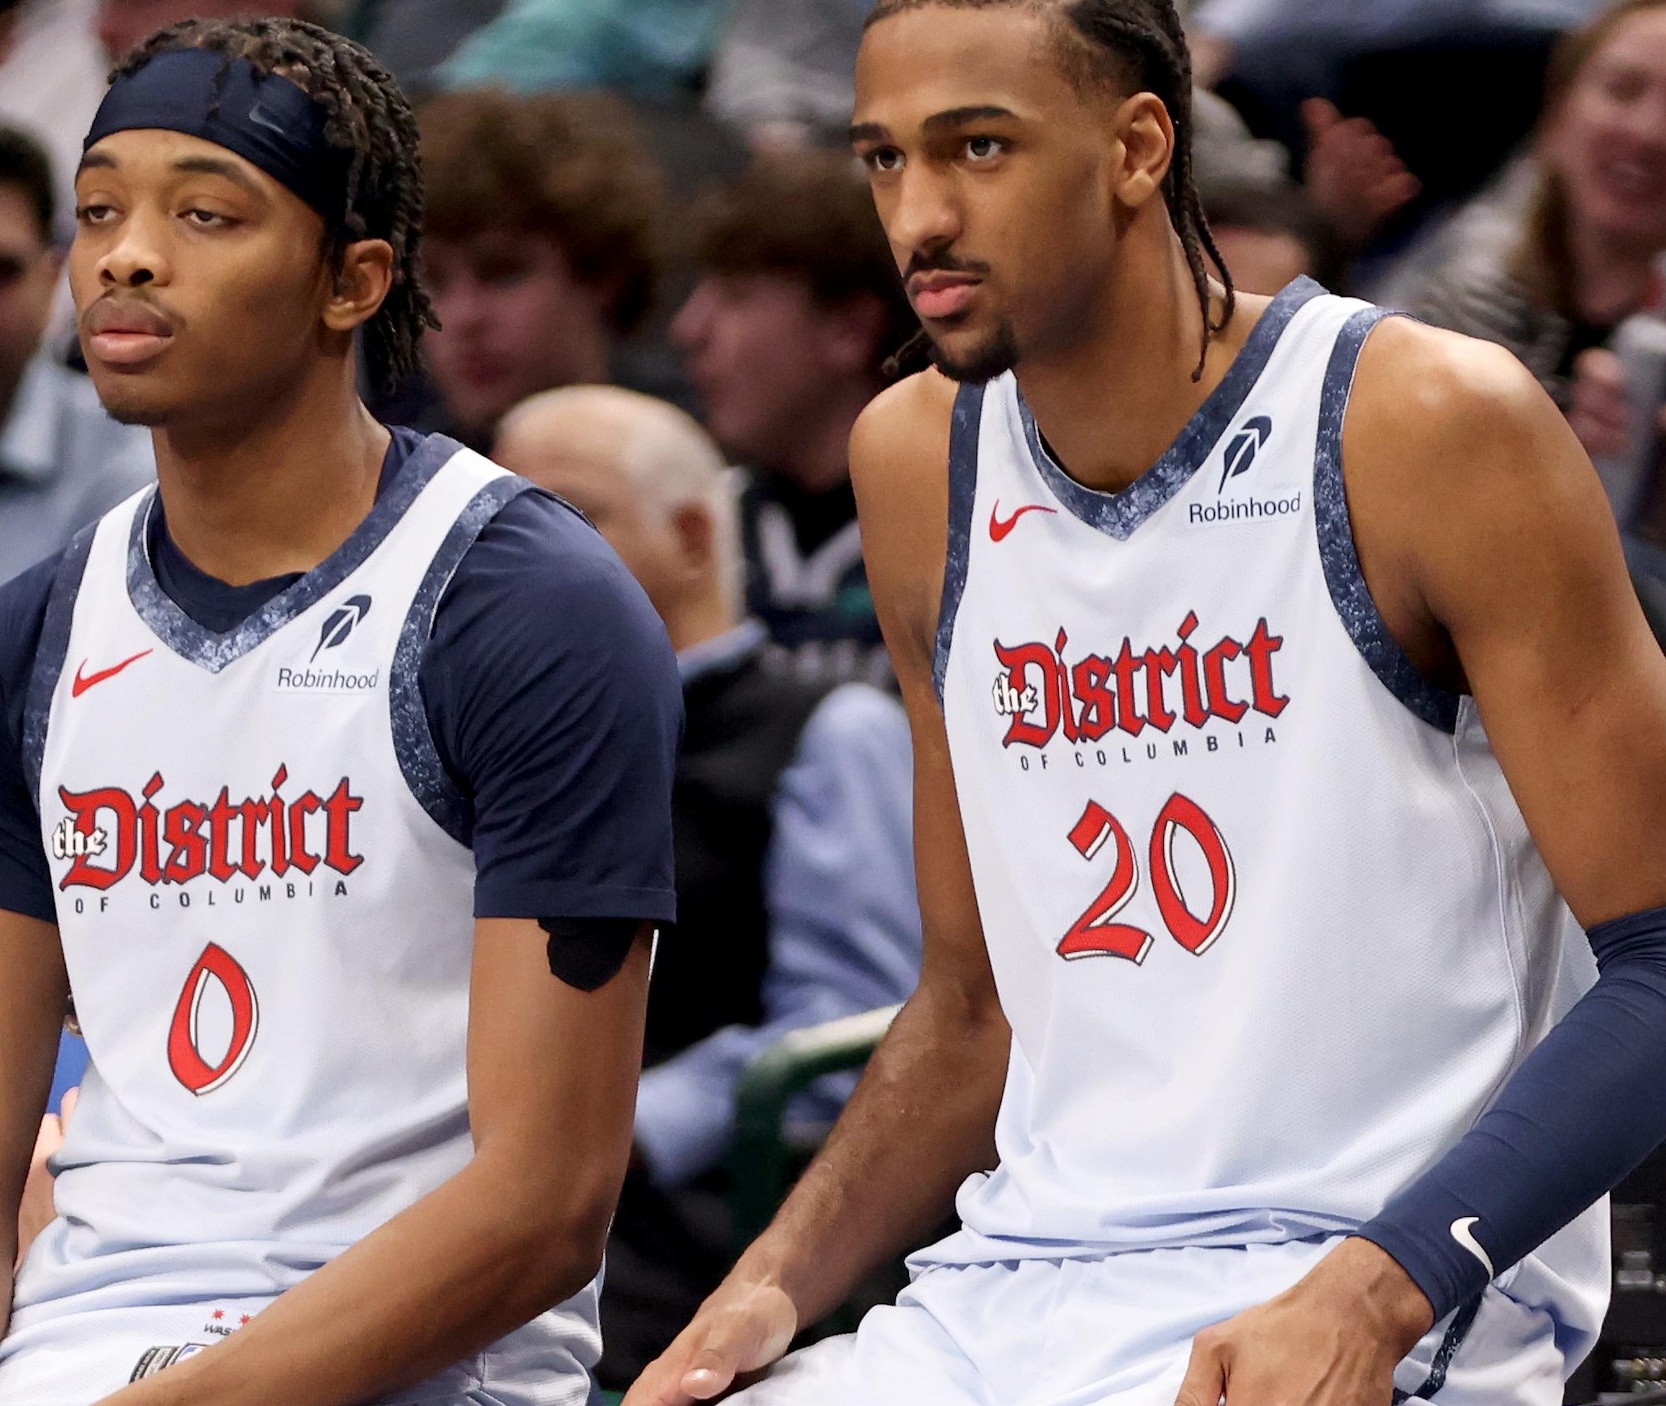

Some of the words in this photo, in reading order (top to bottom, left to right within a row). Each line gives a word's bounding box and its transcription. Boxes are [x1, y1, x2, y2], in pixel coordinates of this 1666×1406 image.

[1189, 490, 1301, 524] Robinhood
[277, 667, 379, 690] Robinhood
[992, 672, 1038, 716] the
[993, 609, 1291, 749] District
[1020, 754, 1049, 772] OF
[1075, 727, 1277, 768] COLUMBIA
[52, 817, 108, 860] the
[58, 762, 365, 892] District
[74, 896, 110, 915] OF
[149, 880, 348, 910] COLUMBIA
[1055, 791, 1237, 967] 20
[167, 941, 259, 1097] 0
